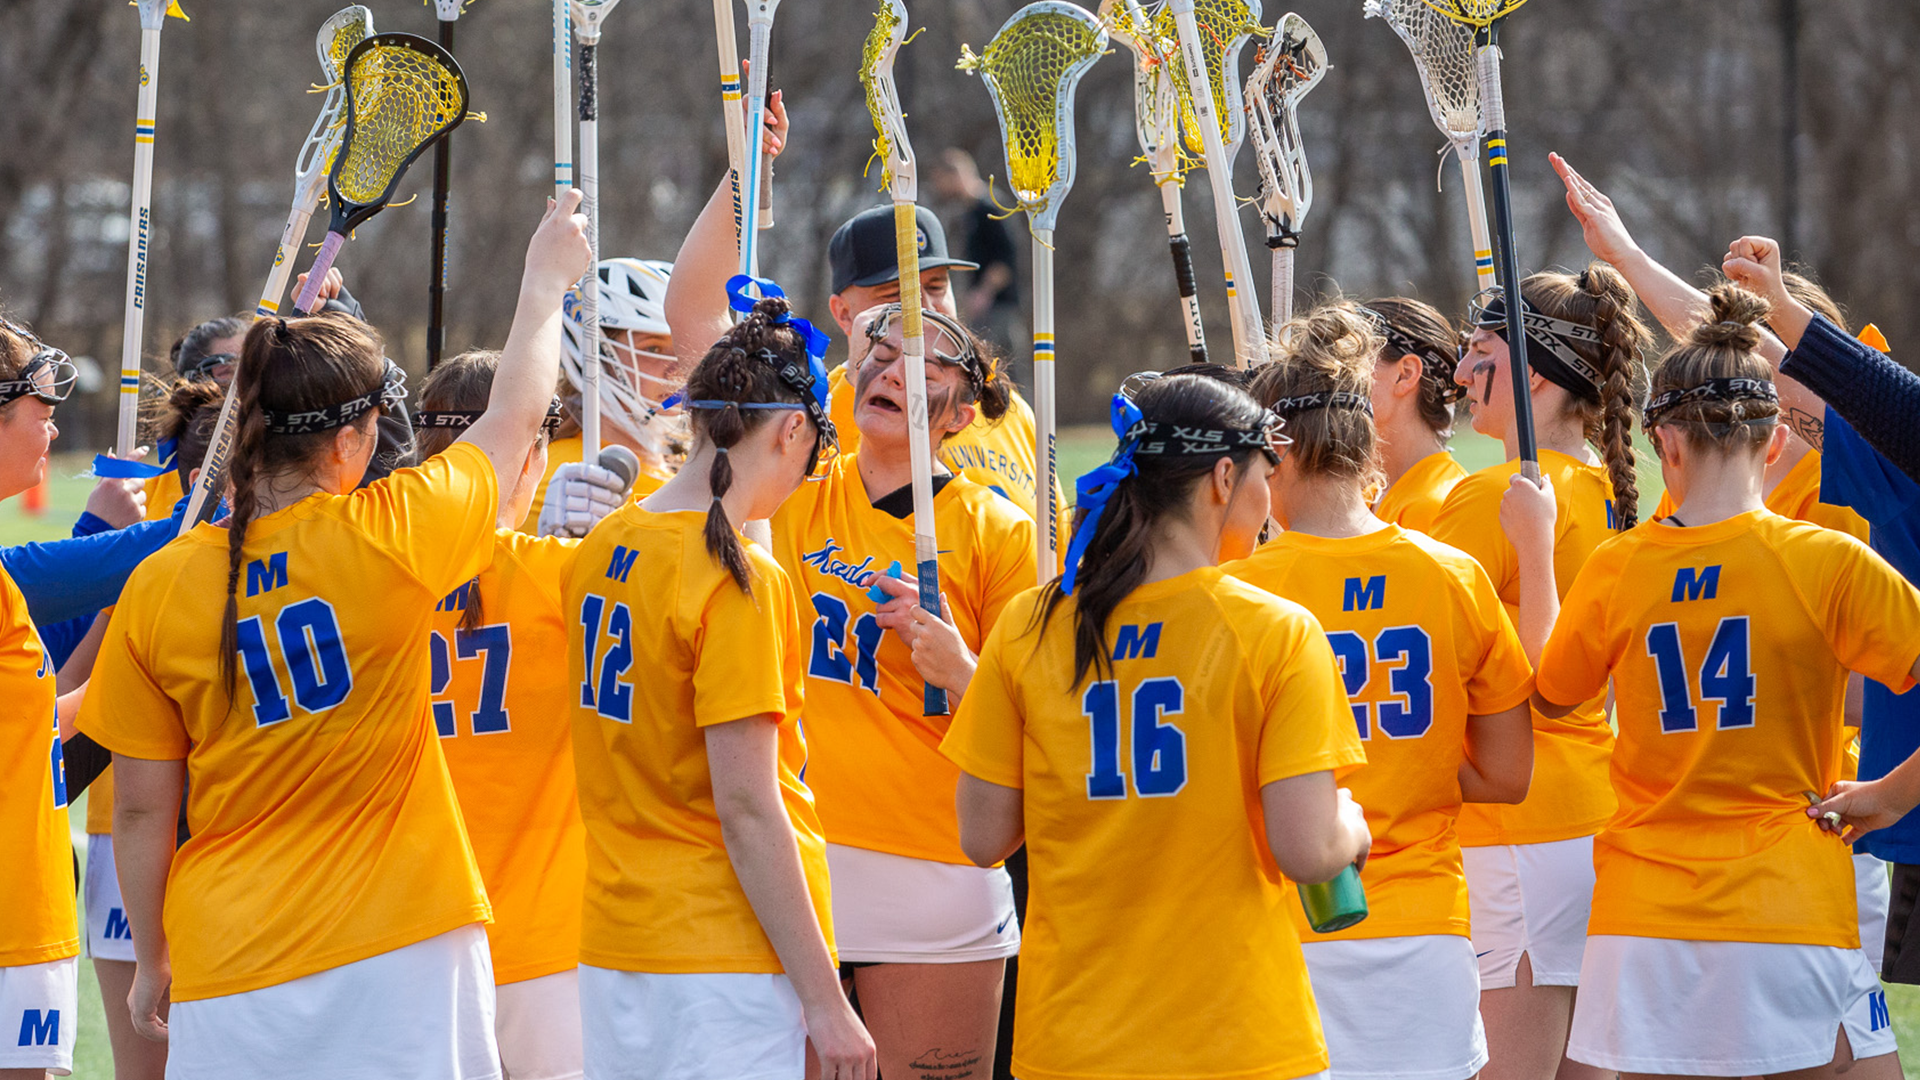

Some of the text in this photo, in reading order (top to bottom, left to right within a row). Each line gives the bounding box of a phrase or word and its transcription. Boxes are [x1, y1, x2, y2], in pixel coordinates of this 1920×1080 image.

[730, 167, 742, 259] SADERS
[134, 206, 149, 310] CRUSADERS
[1571, 358, 1599, 382] STX
[1729, 379, 1763, 391] STX
[287, 409, 329, 425] STX
[340, 395, 372, 417] STX
[810, 401, 832, 435] STX
[1292, 393, 1321, 408] TX
[435, 415, 471, 426] STX
[1172, 425, 1224, 442] STX
[1238, 431, 1265, 444] TX
[948, 444, 1037, 500] UNIVERSIT
[246, 551, 288, 597] M
[606, 545, 640, 583] M
[802, 537, 876, 588] Mado
[1343, 575, 1386, 611] M
[1671, 565, 1722, 603] M
[580, 593, 634, 723] 12
[808, 591, 885, 698] 21
[1113, 622, 1163, 660] M
[236, 596, 353, 728] 10
[1646, 615, 1757, 733] 14
[1325, 624, 1434, 741] 23
[1082, 676, 1188, 800] 16
[18, 1009, 59, 1046] M
